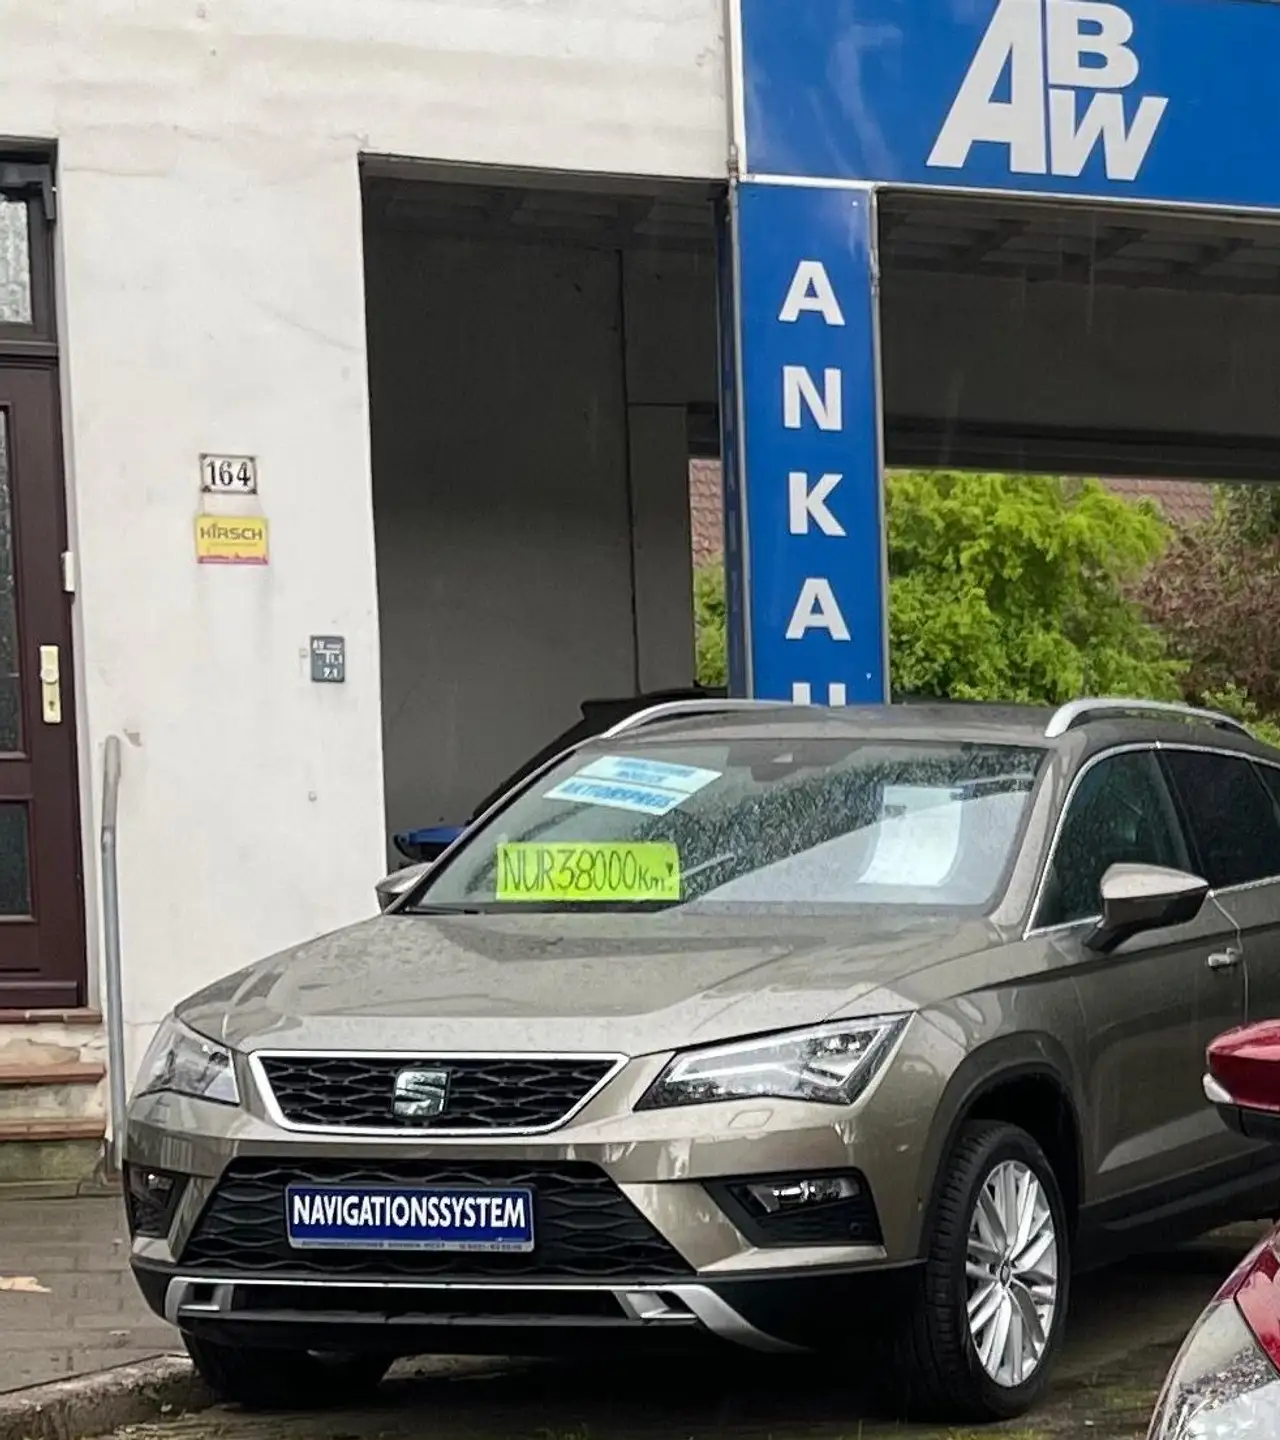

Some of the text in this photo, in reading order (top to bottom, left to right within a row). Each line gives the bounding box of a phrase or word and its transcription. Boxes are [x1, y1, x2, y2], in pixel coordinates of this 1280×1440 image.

[206, 460, 251, 486] 164
[200, 522, 262, 540] HIRSCH
[293, 1195, 526, 1228] NAVIGATIONSSYSTEM
